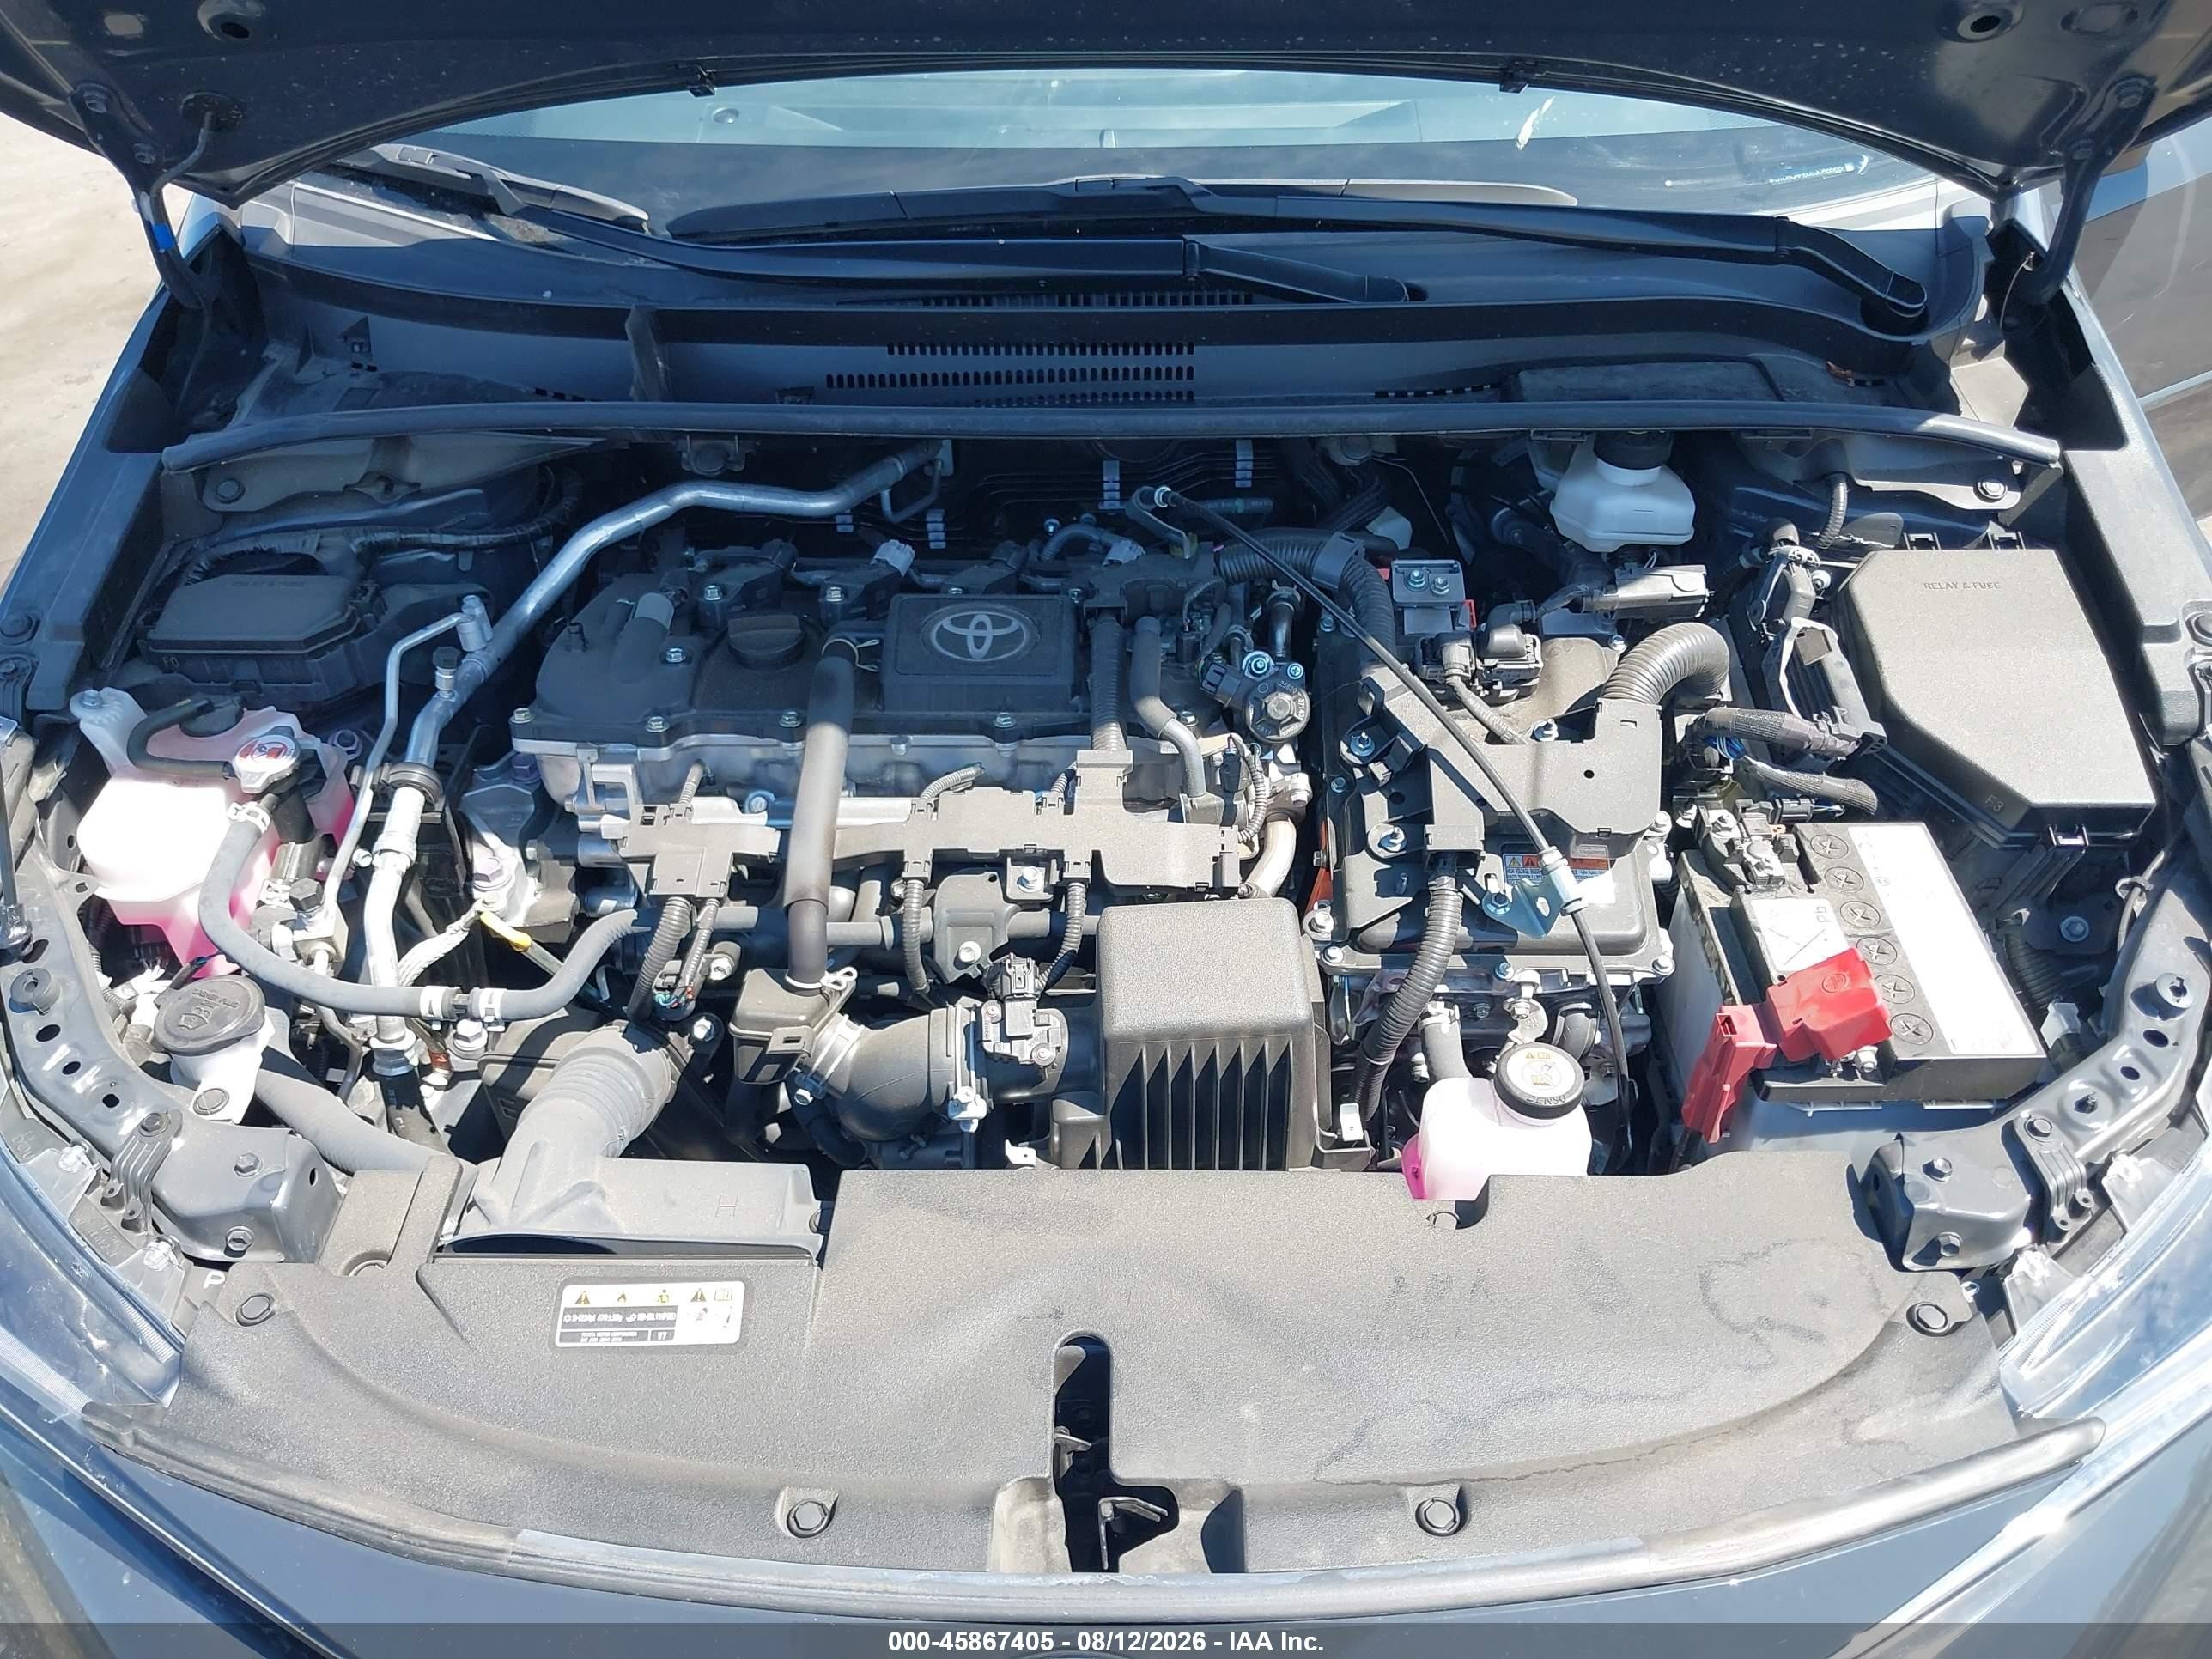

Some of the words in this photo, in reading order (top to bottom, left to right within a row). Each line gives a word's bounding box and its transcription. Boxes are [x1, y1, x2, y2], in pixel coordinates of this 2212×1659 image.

[1985, 795, 2003, 812] F3
[1526, 1095, 1567, 1105] DENSO
[203, 1271, 226, 1289] P
